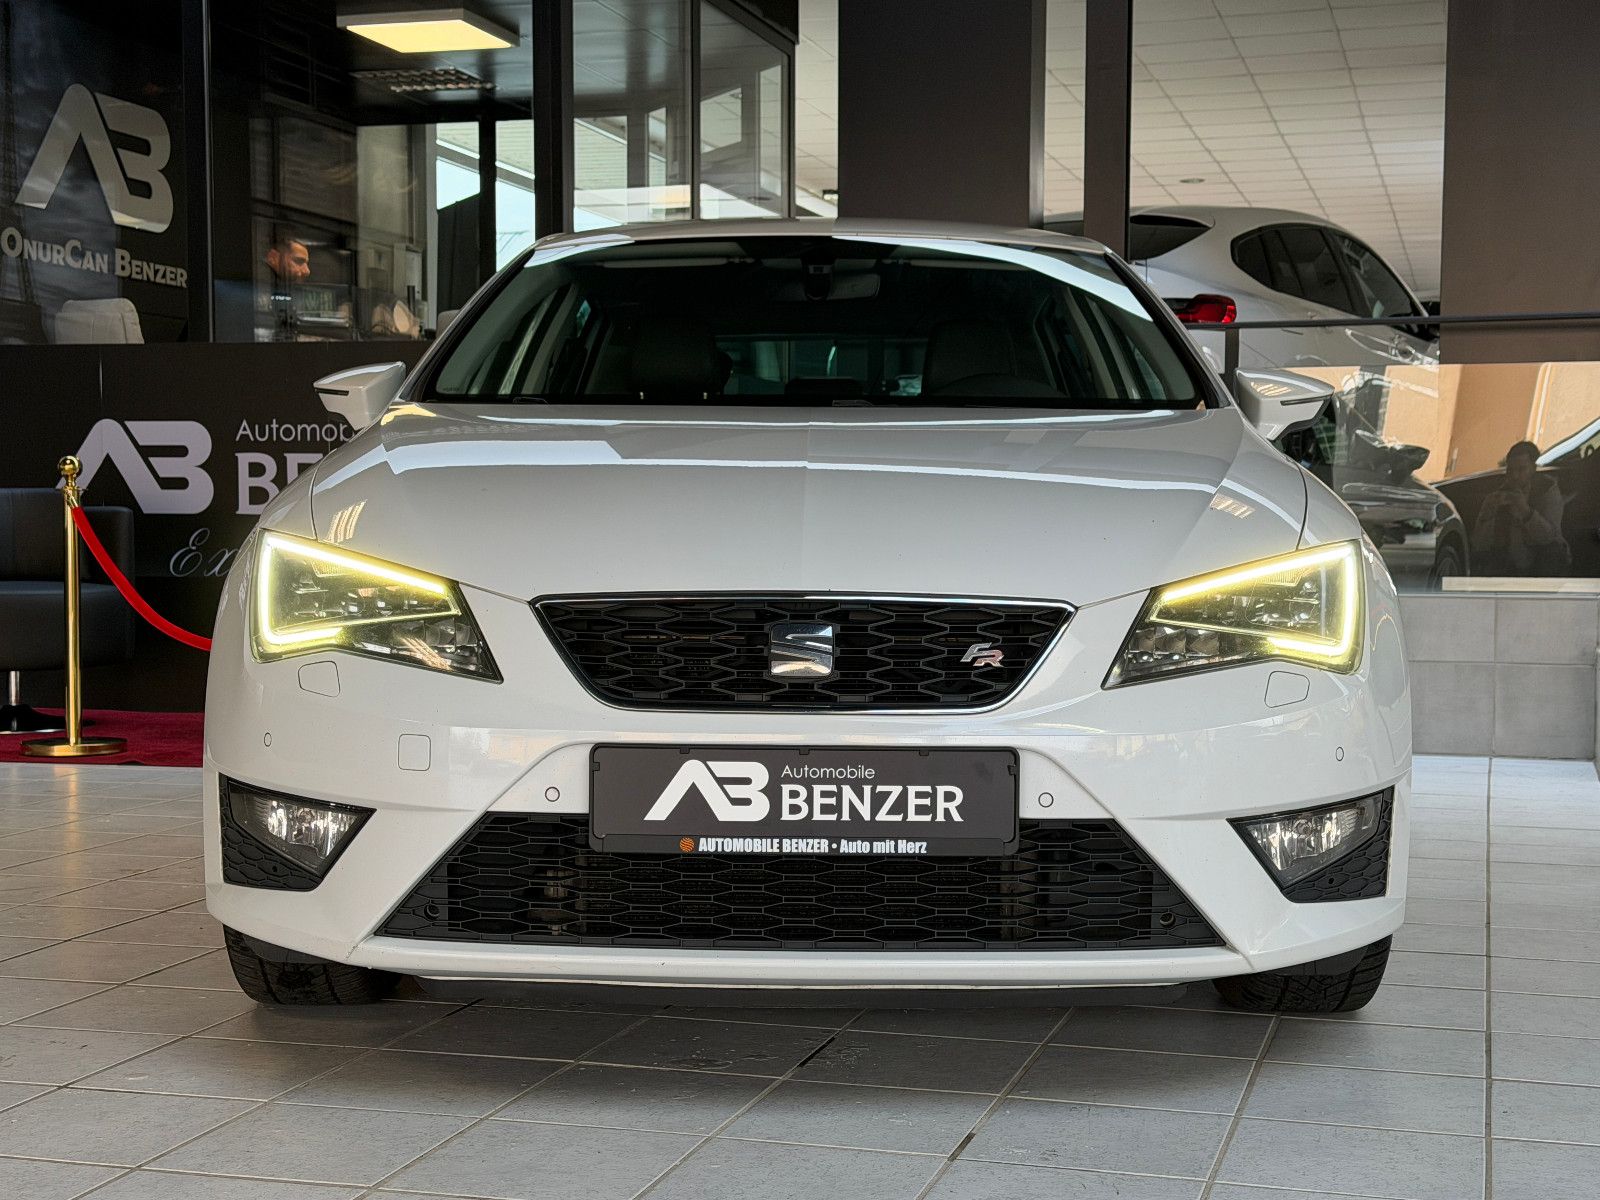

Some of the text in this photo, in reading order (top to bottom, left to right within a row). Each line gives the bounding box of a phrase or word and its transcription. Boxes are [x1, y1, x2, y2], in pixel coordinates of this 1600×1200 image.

[960, 642, 1005, 667] FR
[780, 764, 876, 780] Automobile
[780, 784, 965, 822] BENZER
[698, 837, 928, 854] AUTOMOBILE BENZER Auto mit Herz
